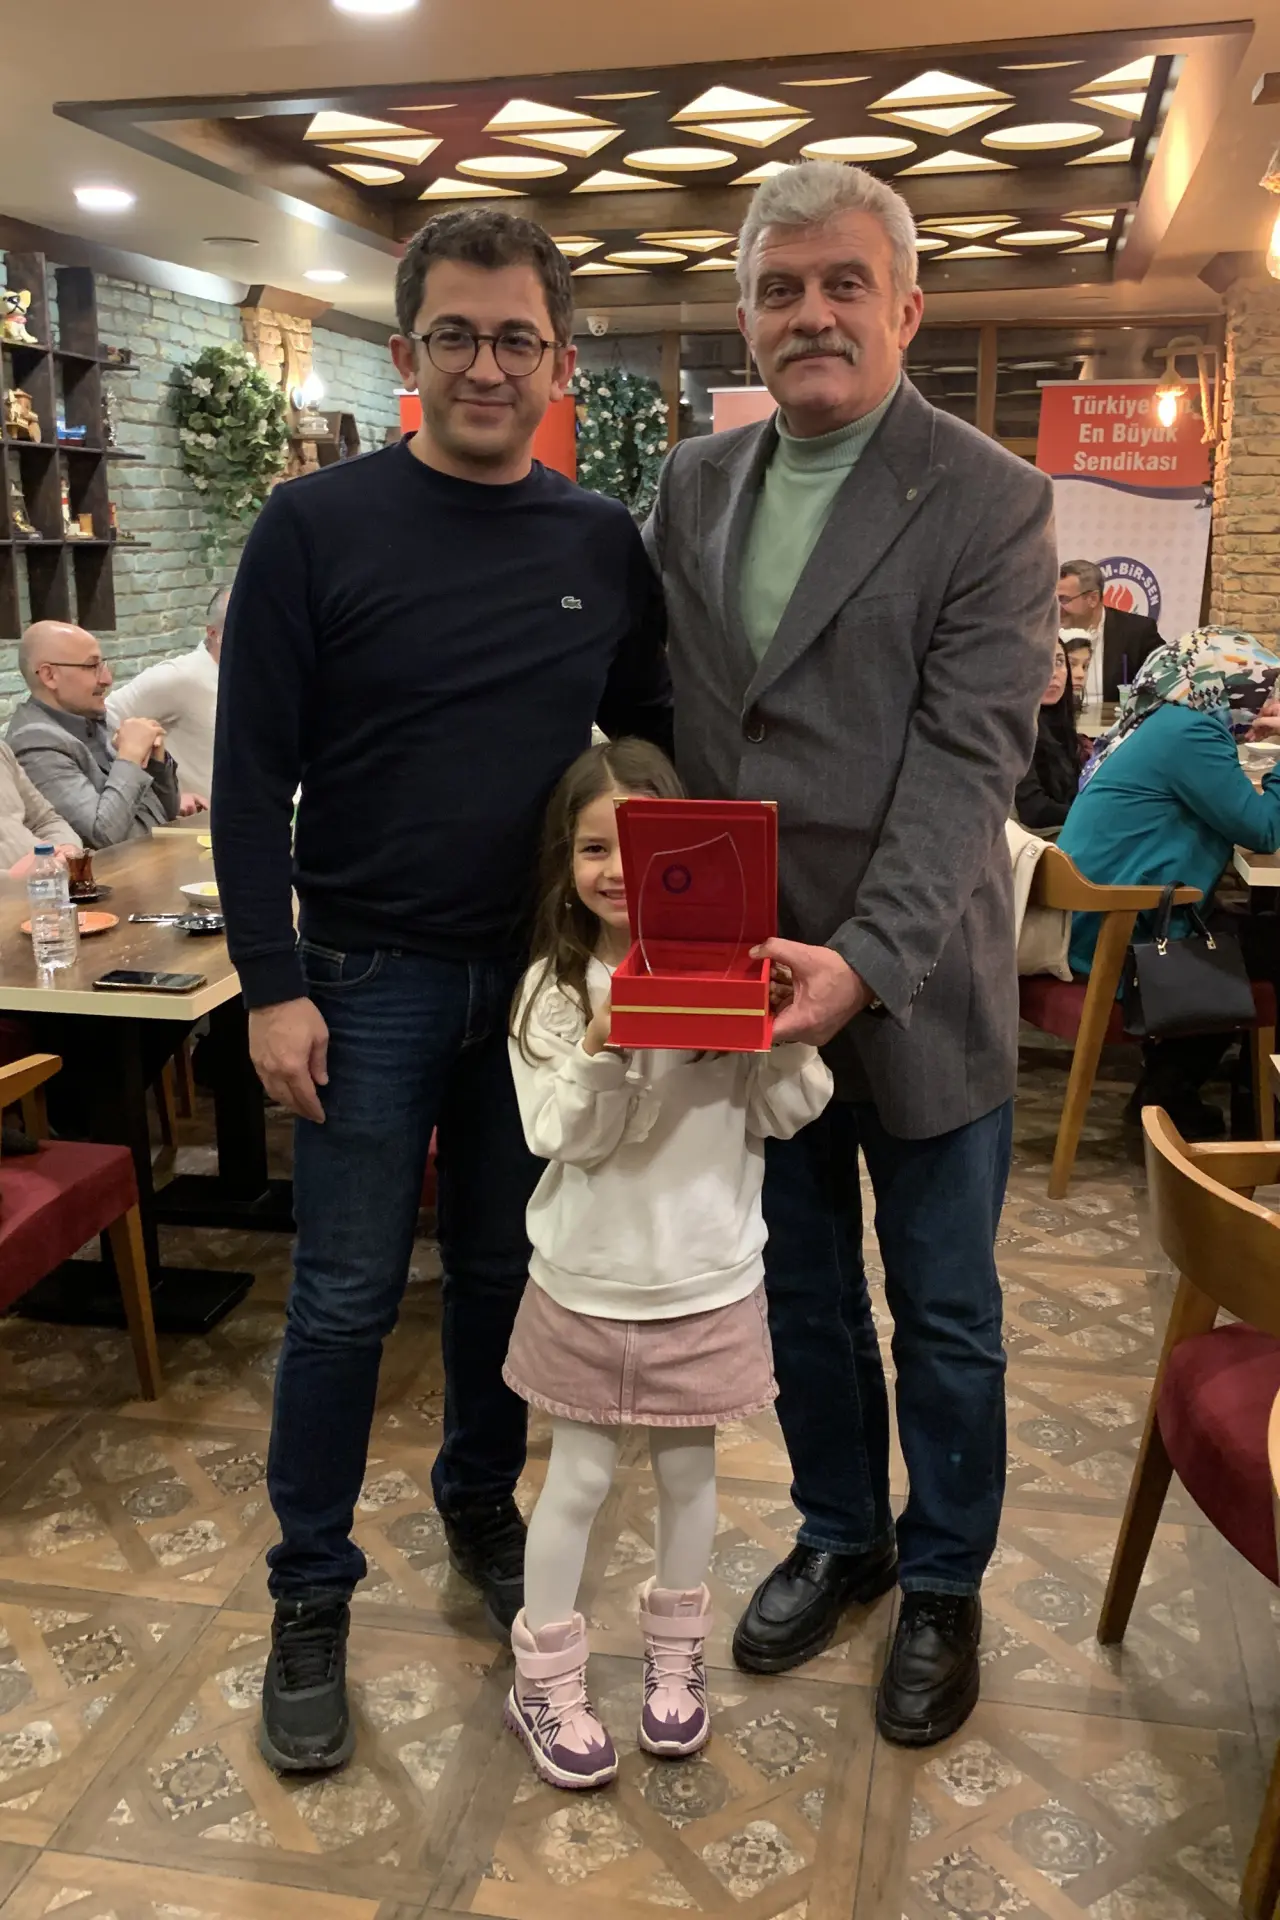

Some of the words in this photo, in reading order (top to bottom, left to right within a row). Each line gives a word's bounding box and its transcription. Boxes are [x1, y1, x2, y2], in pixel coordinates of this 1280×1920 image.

[1079, 423, 1105, 443] En
[1112, 422, 1178, 447] Büyük
[1073, 451, 1177, 471] Sendikası
